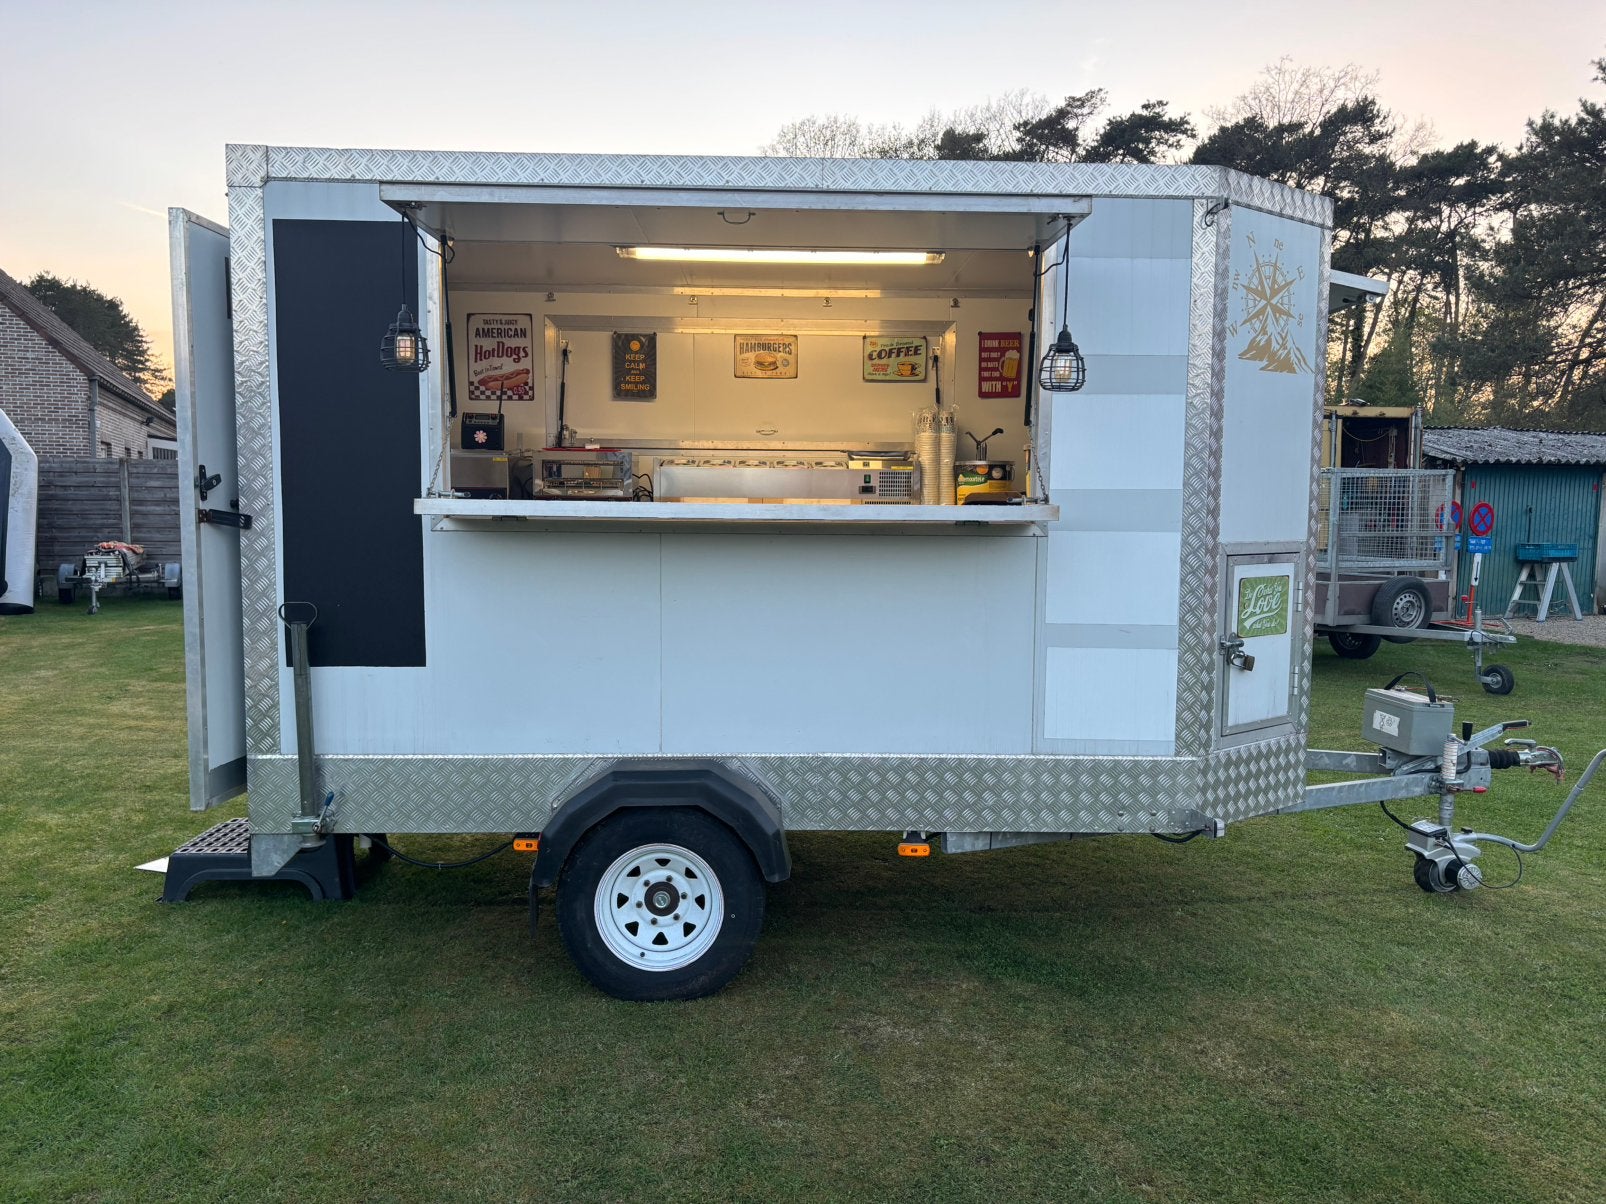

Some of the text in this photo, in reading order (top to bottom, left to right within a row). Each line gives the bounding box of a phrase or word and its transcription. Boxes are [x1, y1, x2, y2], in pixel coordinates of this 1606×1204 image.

[474, 327, 527, 339] AMERICAN
[739, 342, 793, 356] HAMBURGERS
[984, 340, 1000, 348] DRINK
[1000, 339, 1020, 348] BEER
[625, 353, 646, 361] KEEP
[867, 344, 923, 361] COFFEE
[625, 362, 646, 370] CALM
[620, 383, 650, 391] SMILING
[981, 381, 1002, 393] WITH
[1241, 584, 1283, 619] Love
